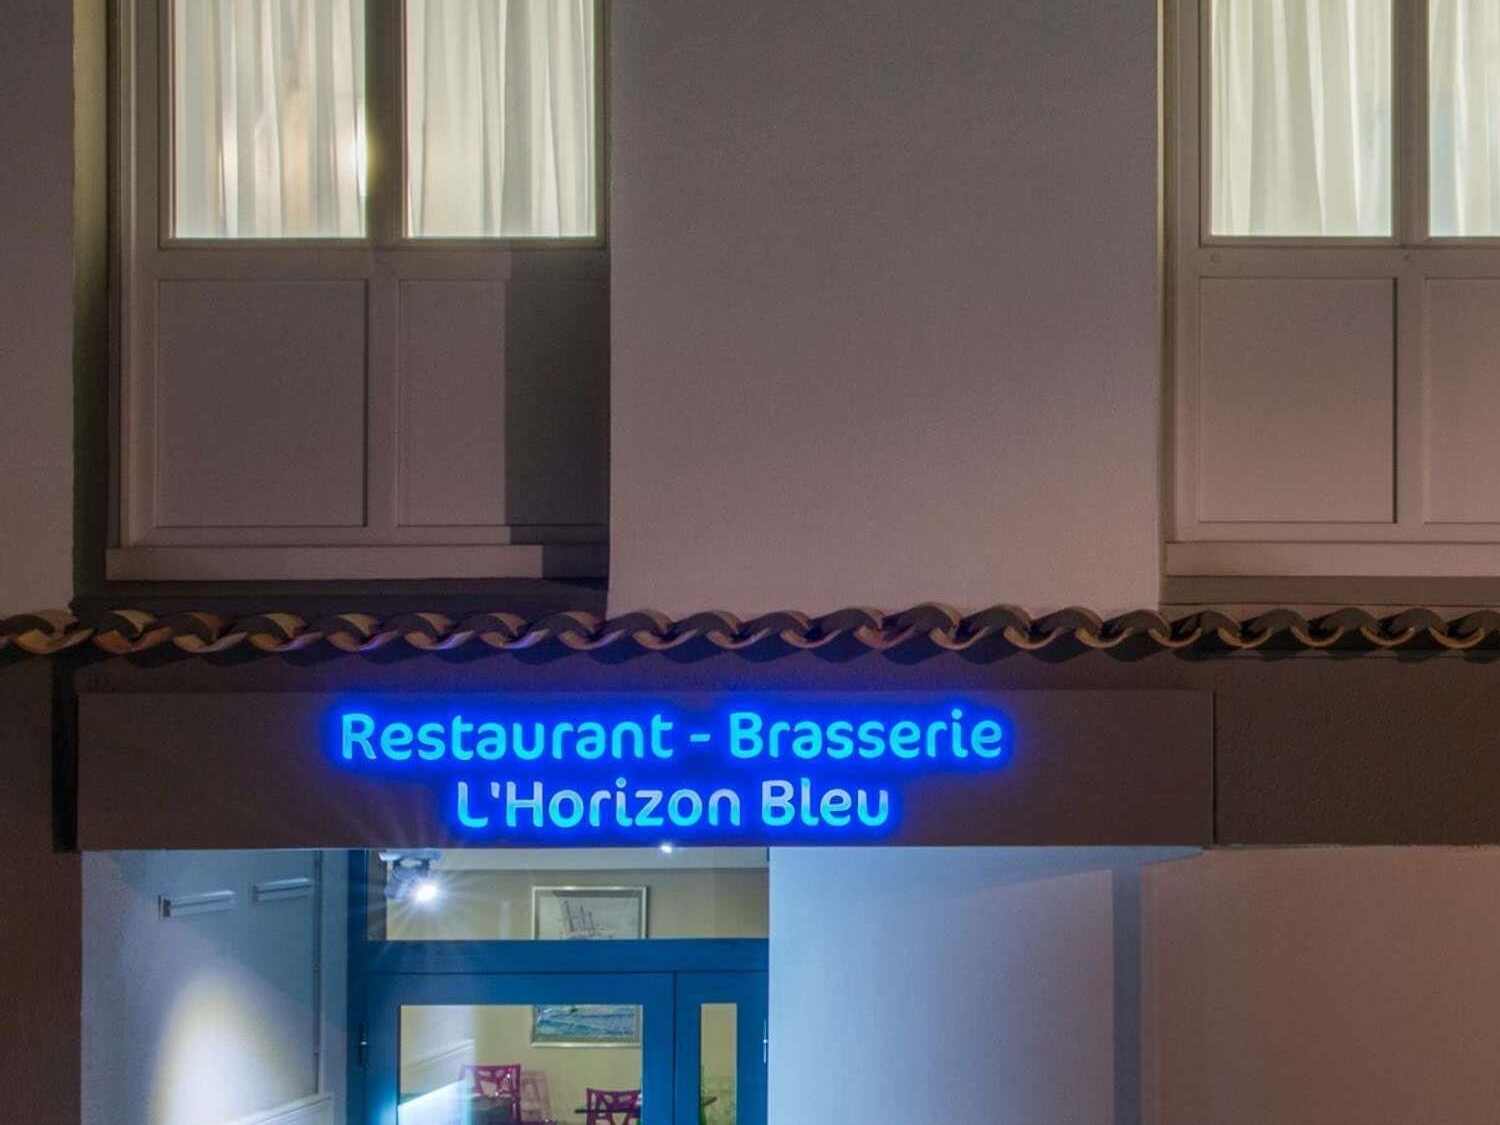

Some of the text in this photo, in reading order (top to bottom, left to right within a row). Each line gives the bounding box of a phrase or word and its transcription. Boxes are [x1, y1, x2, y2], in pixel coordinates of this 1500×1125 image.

[341, 709, 1003, 761] Restaurant - Brasserie
[456, 777, 890, 828] L'Horizon Bleu
